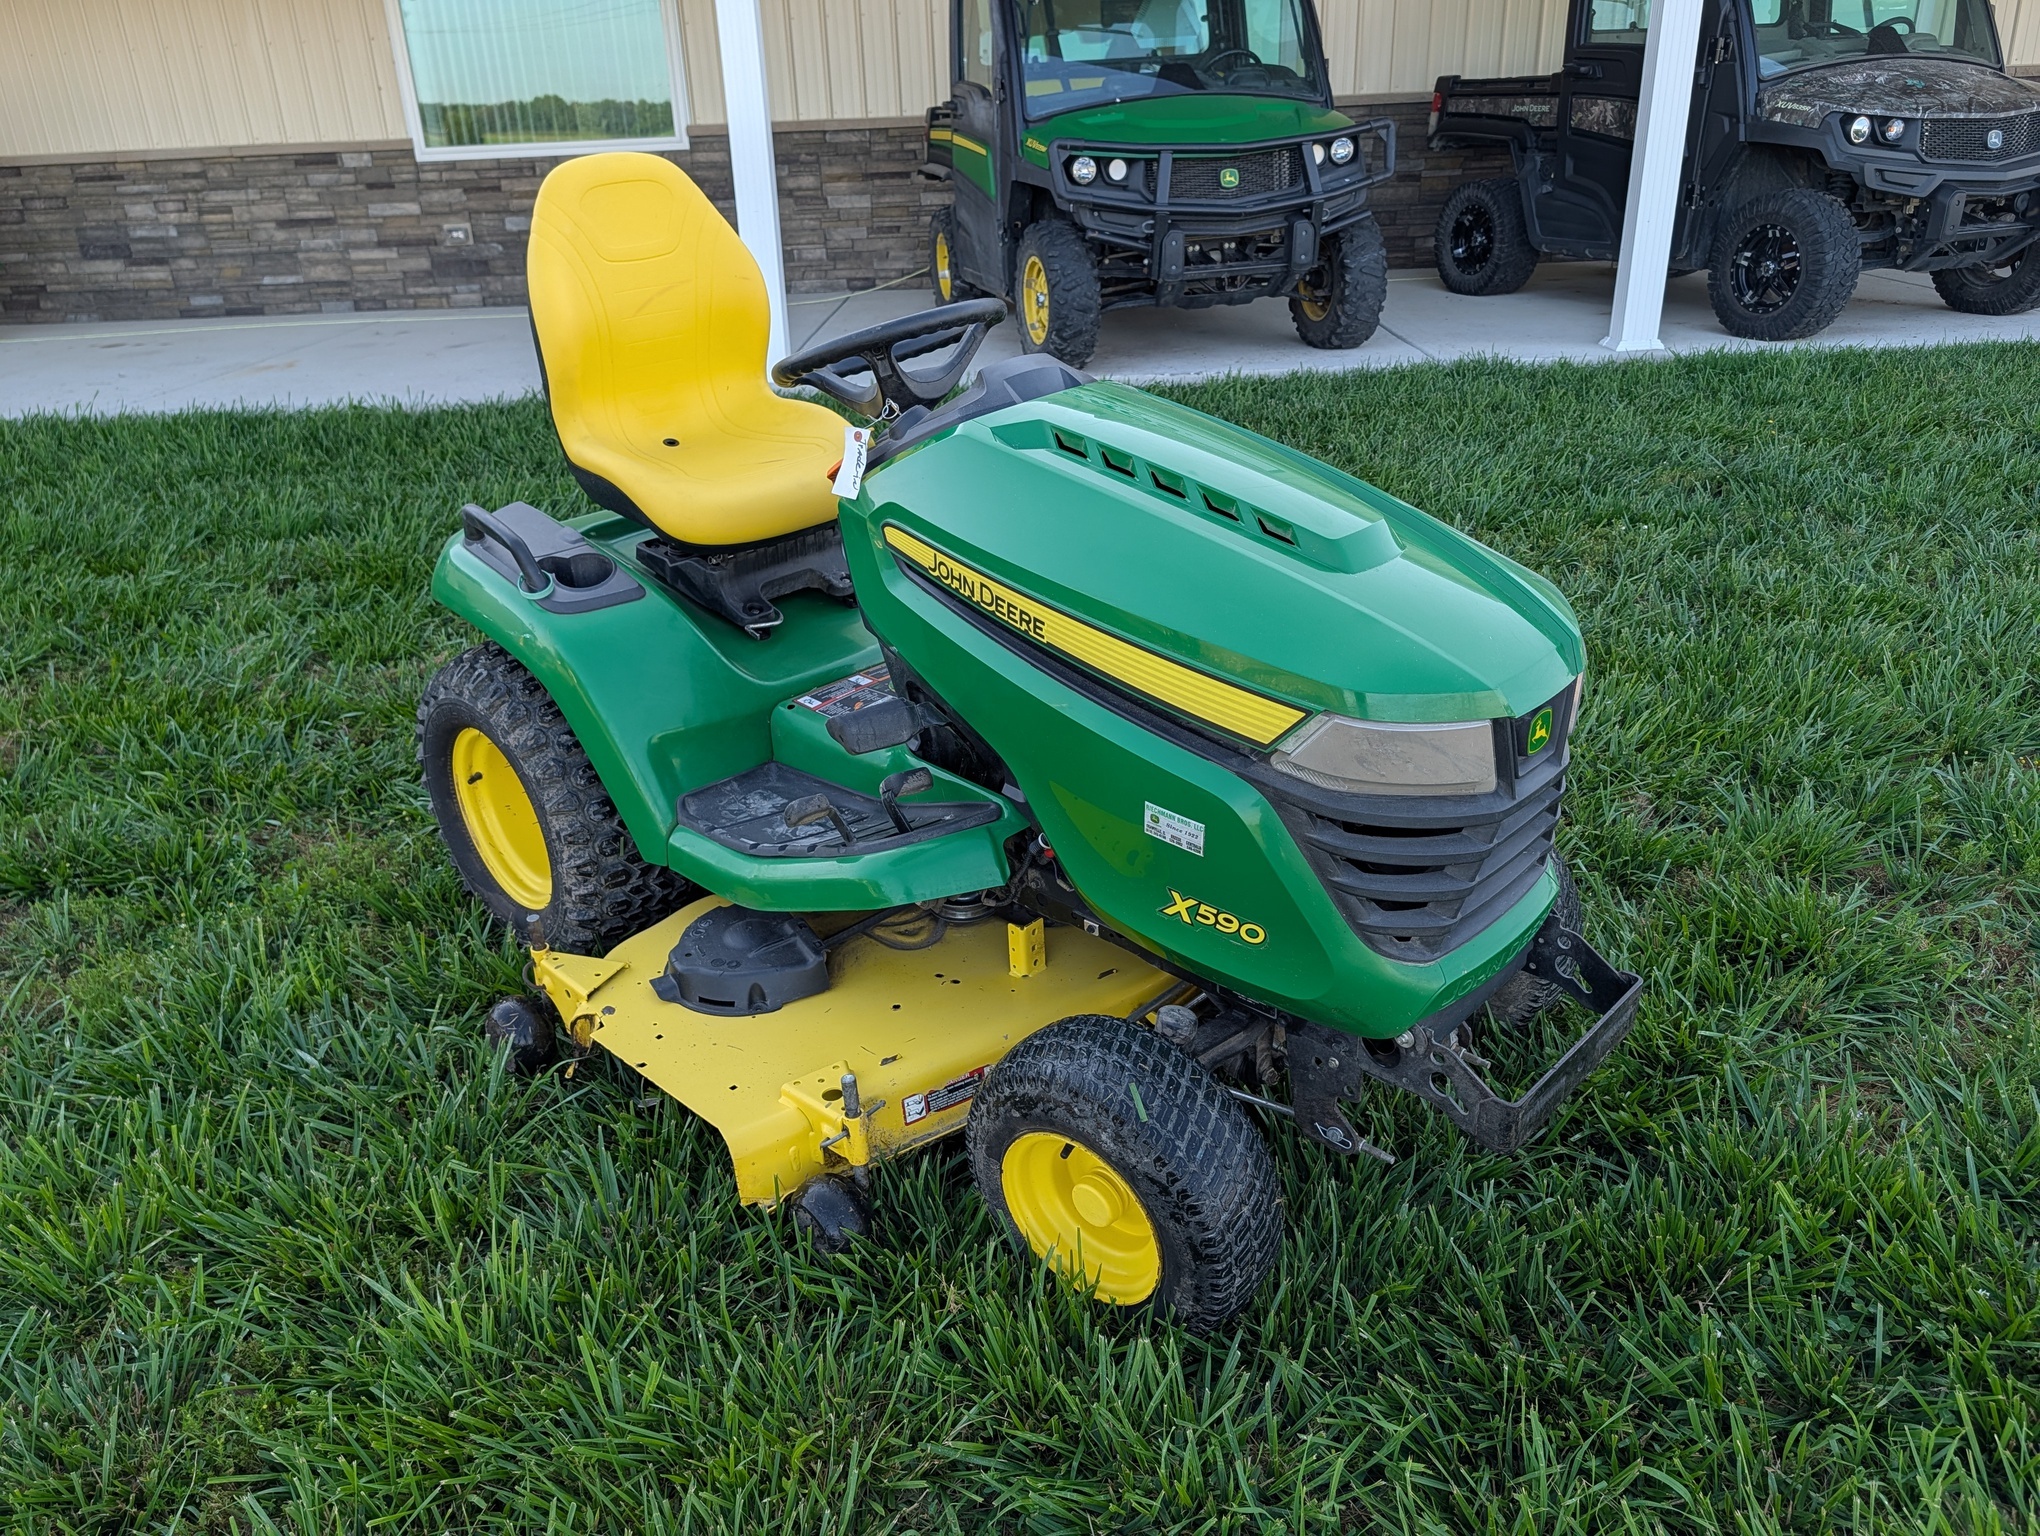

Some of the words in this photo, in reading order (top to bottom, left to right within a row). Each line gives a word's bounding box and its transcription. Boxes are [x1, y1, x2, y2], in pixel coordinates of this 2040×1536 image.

[1512, 104, 1529, 112] JOHN
[1530, 104, 1550, 112] DEERE
[928, 552, 975, 600] JOHN
[979, 580, 1045, 640] DEERE
[1160, 887, 1266, 945] X590
